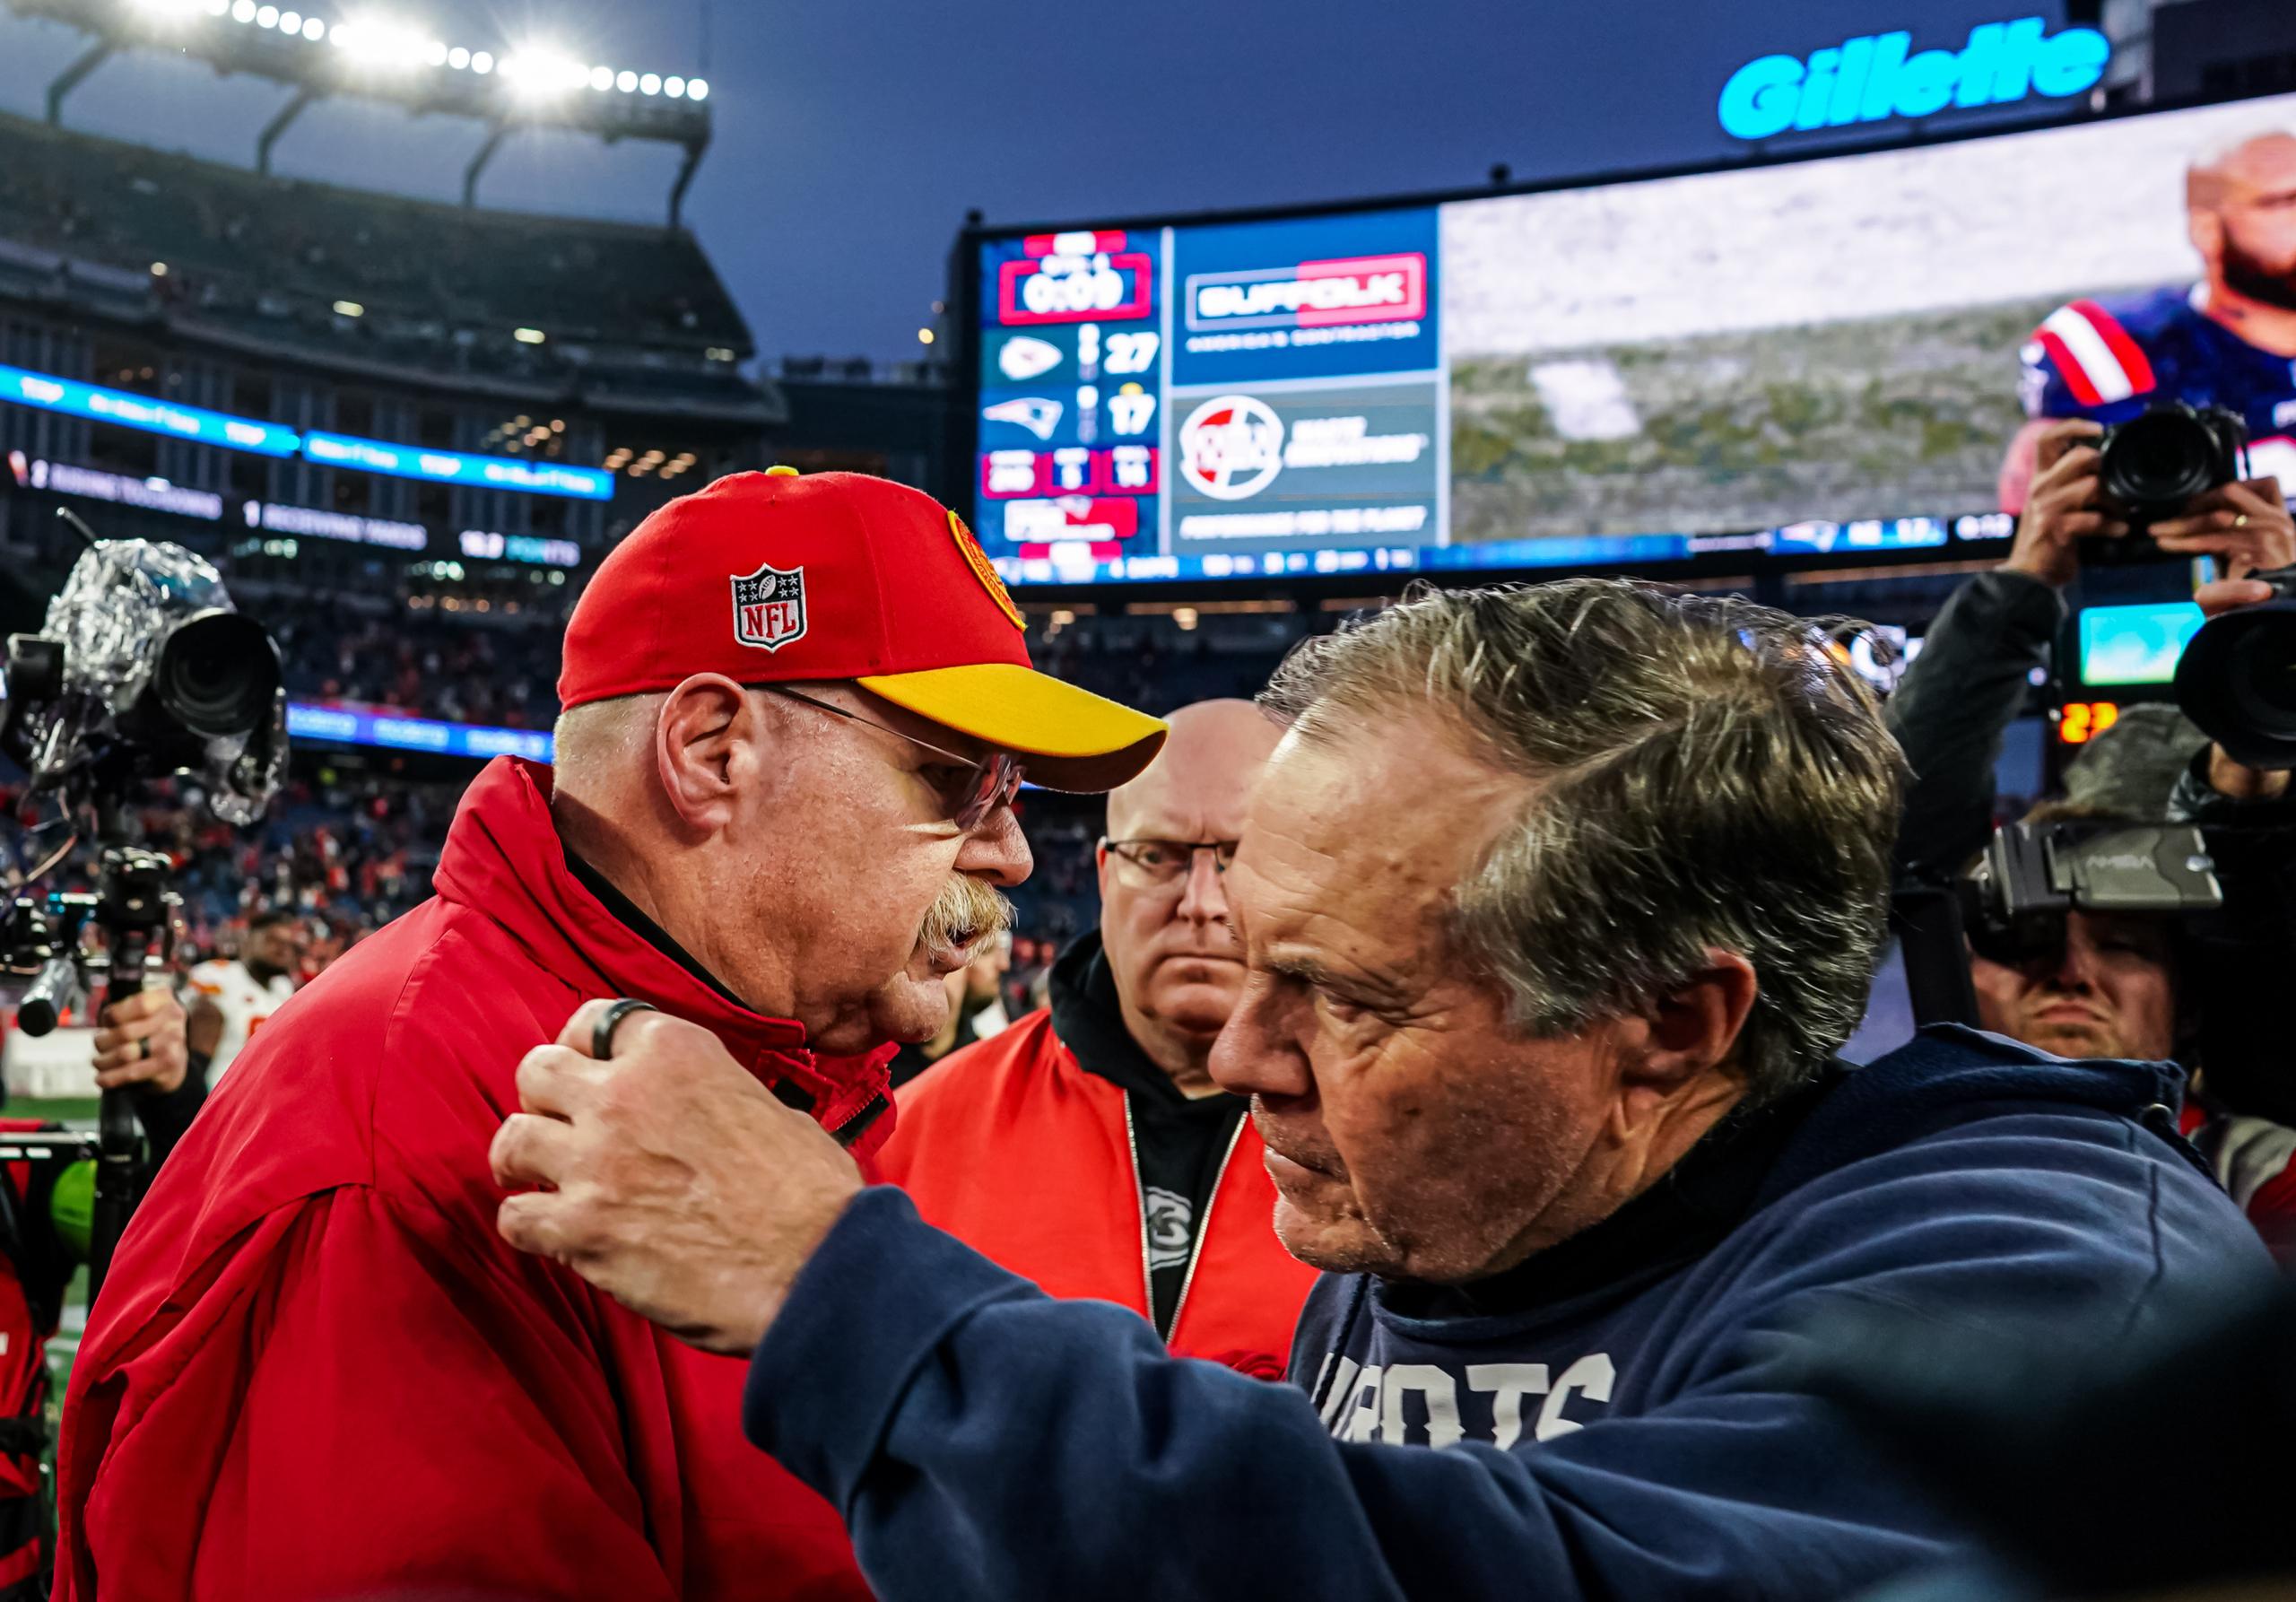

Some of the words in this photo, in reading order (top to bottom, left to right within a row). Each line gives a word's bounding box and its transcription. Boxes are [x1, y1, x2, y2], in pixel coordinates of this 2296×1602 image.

[1718, 17, 2110, 140] Gillette
[1104, 332, 1160, 374] 27
[1108, 393, 1156, 435] 17
[744, 602, 796, 639] NFL
